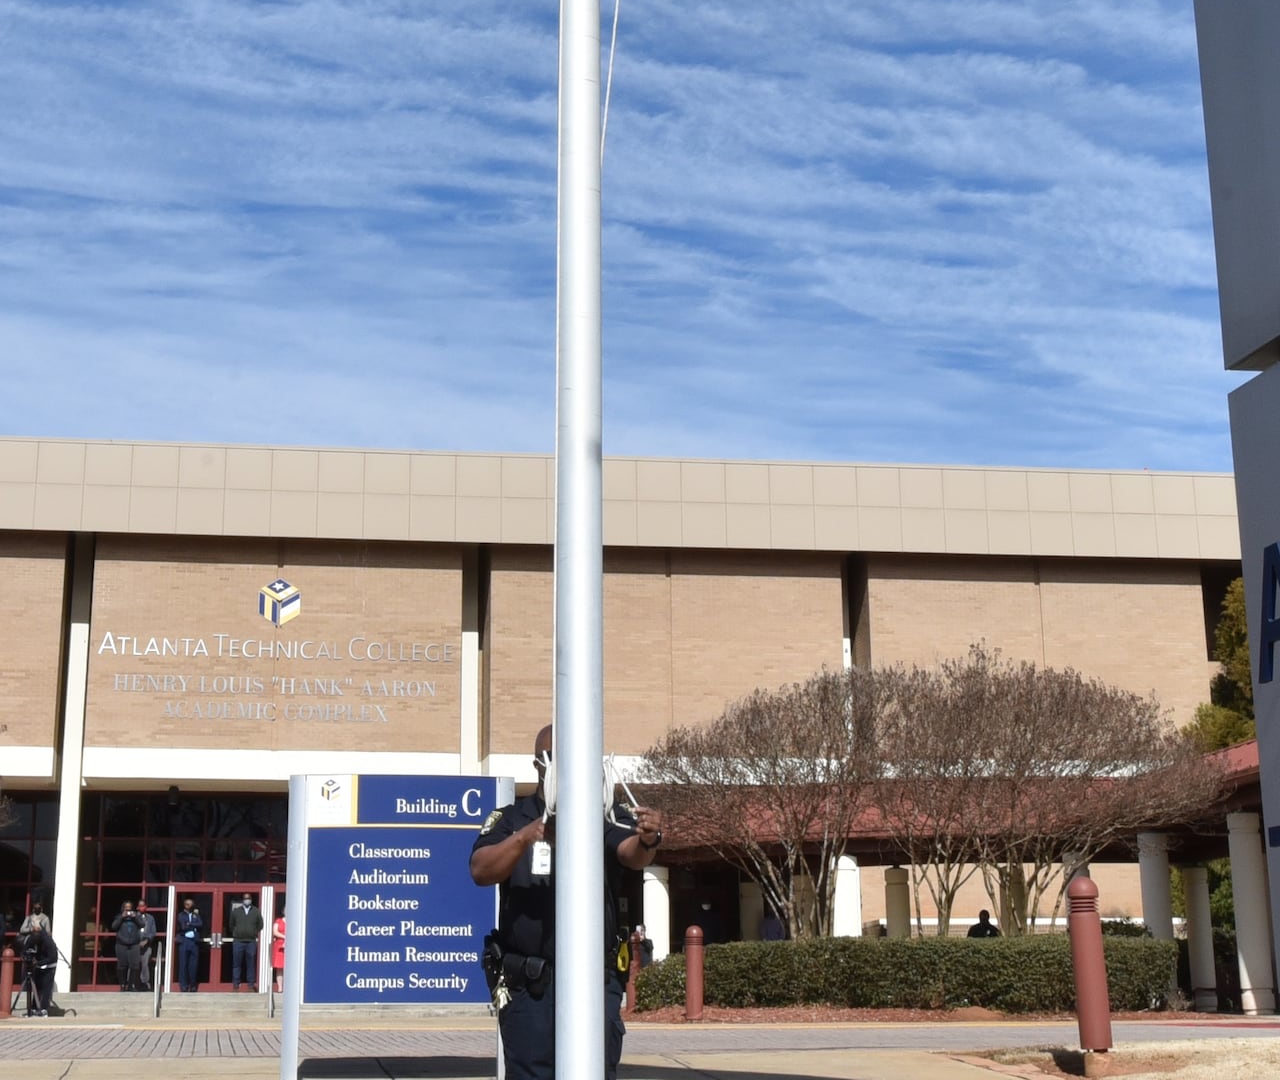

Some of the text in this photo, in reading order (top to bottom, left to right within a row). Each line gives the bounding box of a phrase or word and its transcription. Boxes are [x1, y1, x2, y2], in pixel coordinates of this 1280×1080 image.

[97, 631, 455, 664] ATLANTA TECHNICAL COLLEGE
[112, 673, 437, 698] HENRY LOUIS "HANK" AARON
[162, 700, 389, 723] ACADEMIC COMPLEX
[396, 788, 482, 818] Building C
[349, 843, 431, 859] Classrooms
[348, 869, 429, 885] Auditorium
[347, 894, 419, 910] Bookstore
[346, 920, 472, 936] Career Placement
[346, 946, 478, 962] Human Resources
[345, 973, 469, 993] Campus Security
